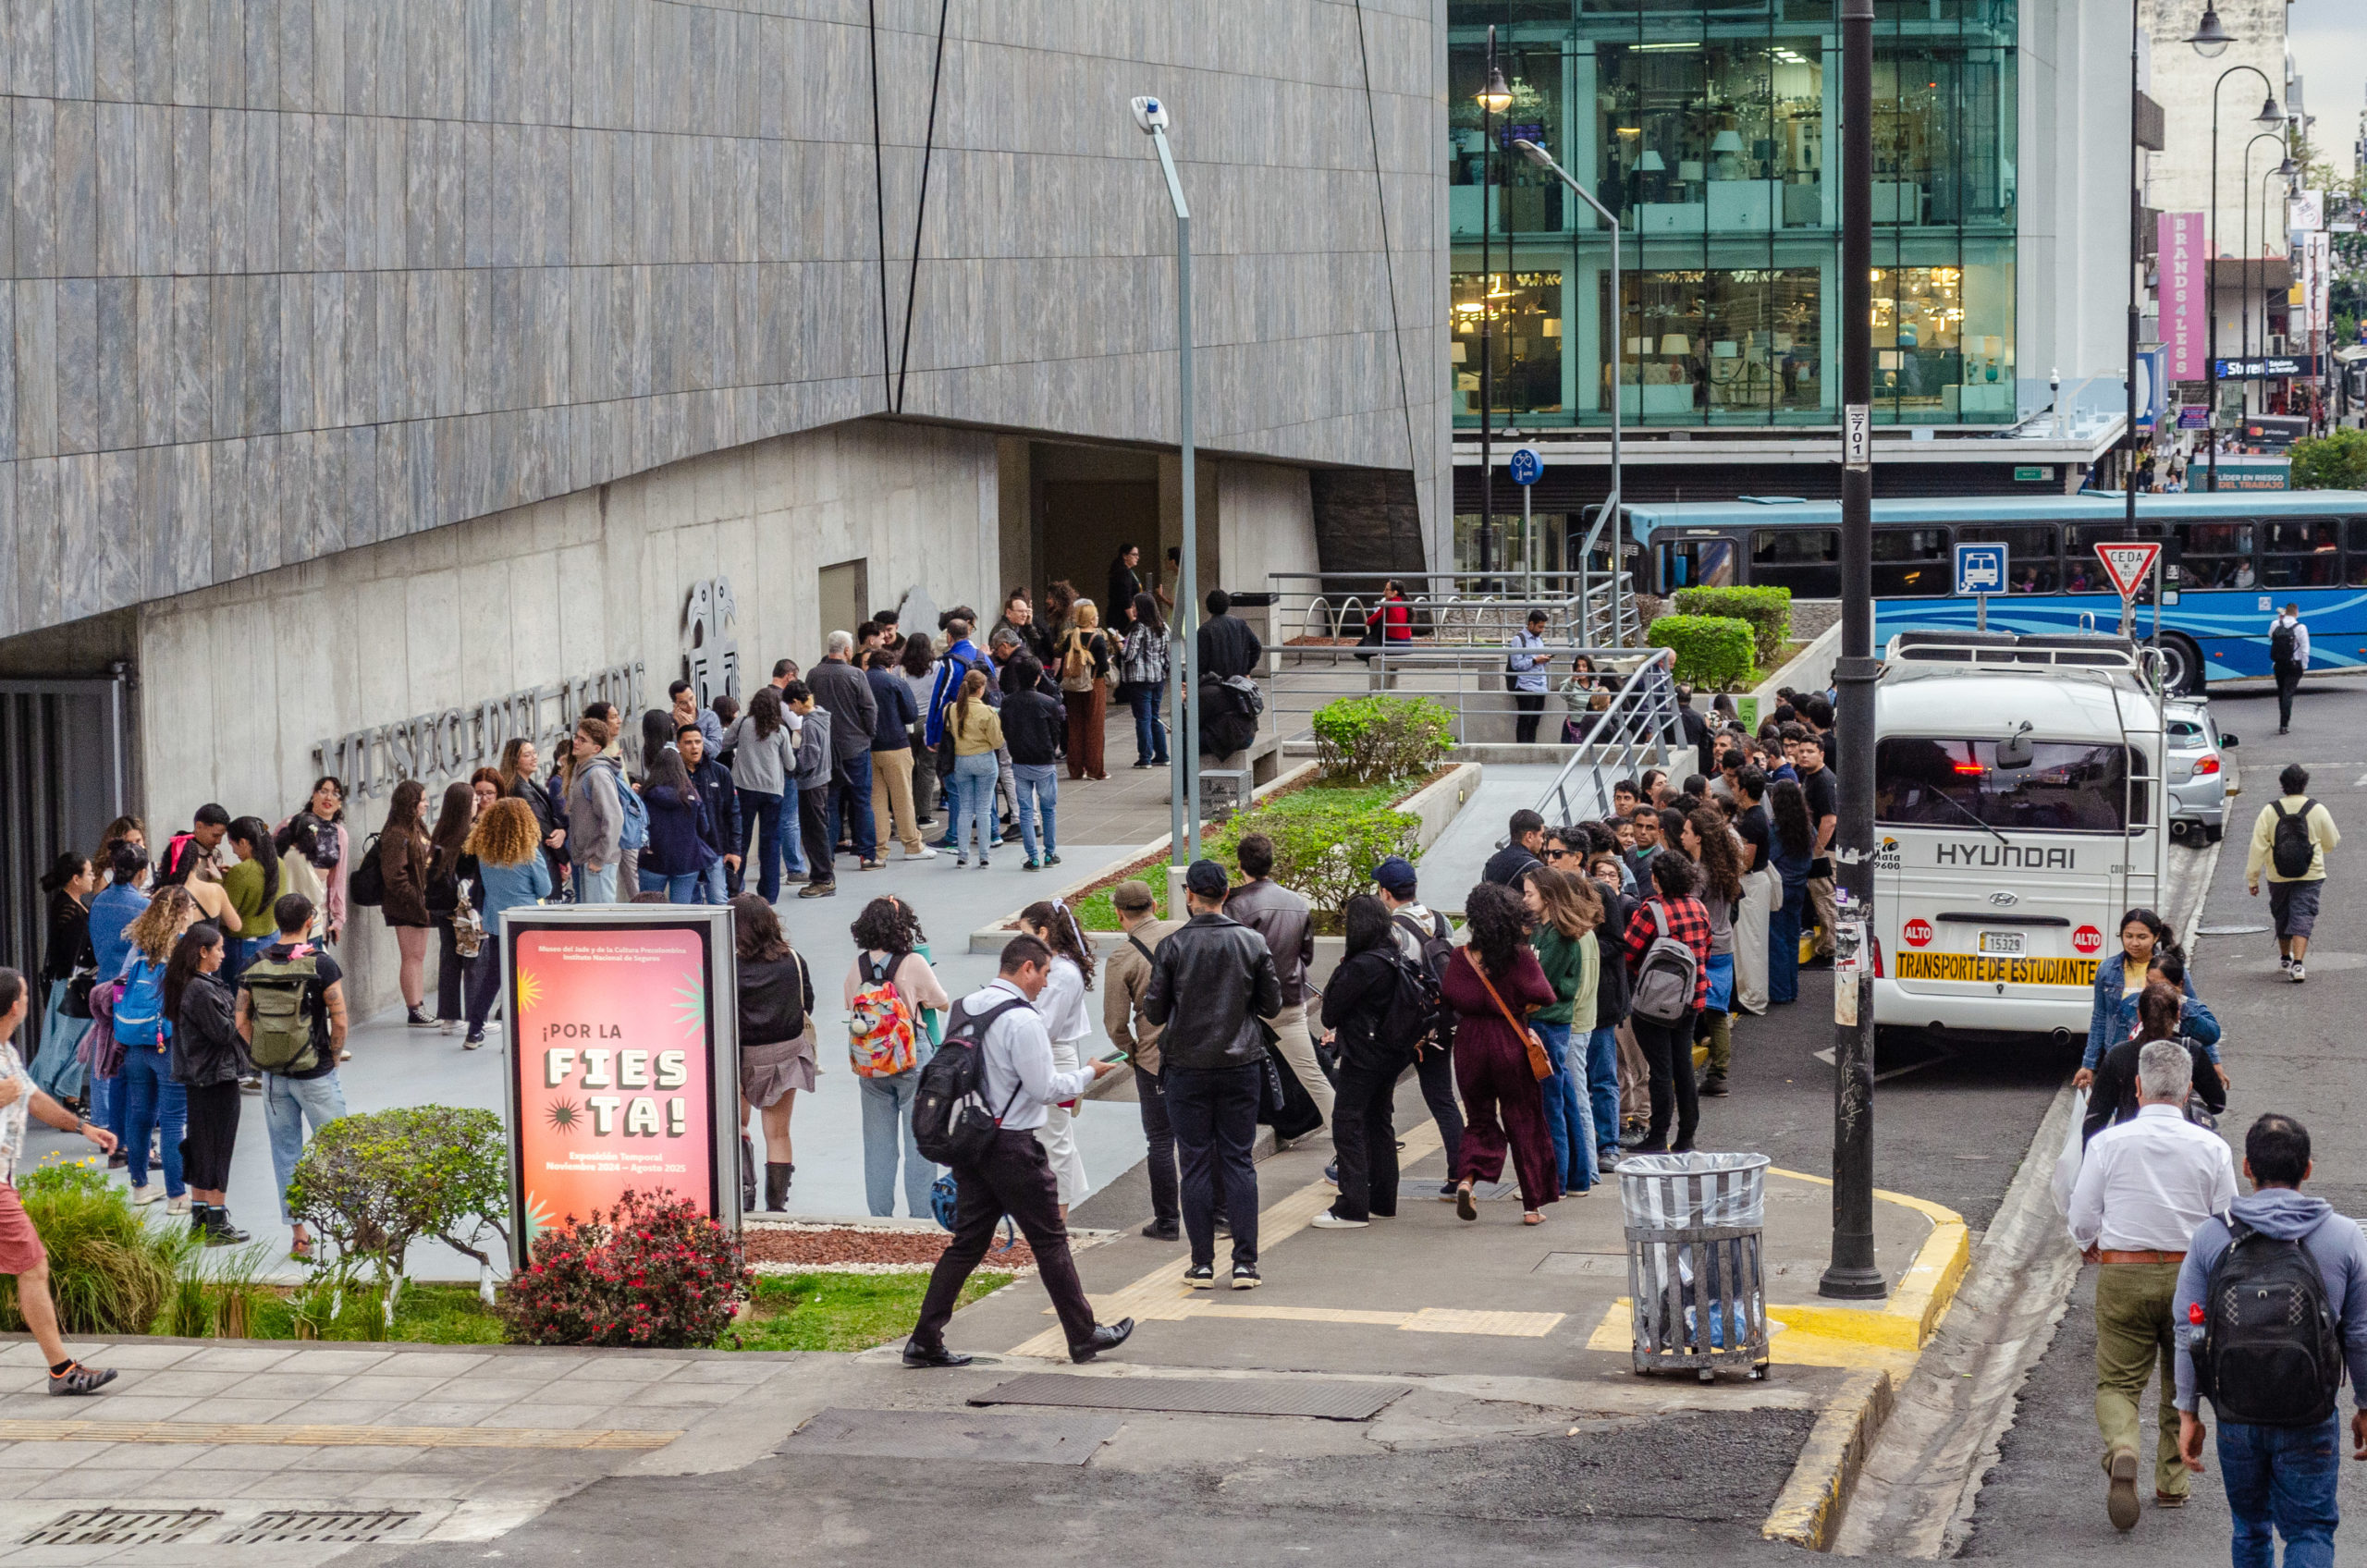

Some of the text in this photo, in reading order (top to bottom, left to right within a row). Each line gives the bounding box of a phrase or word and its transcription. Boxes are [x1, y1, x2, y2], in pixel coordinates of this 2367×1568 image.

[2226, 361, 2264, 375] Stren
[1852, 421, 1862, 454] 701
[2218, 472, 2284, 482] LÍDER EN RIESGO
[2218, 481, 2285, 489] DEL TRABAJO
[2111, 551, 2143, 562] CEDA
[321, 707, 469, 805] MUSEO
[480, 684, 554, 768] DEL
[1936, 842, 2076, 869] HYUNDAI
[1873, 862, 1900, 870] 9600
[2111, 864, 2137, 874] COUTY
[1905, 926, 1932, 940] ALTO
[1990, 937, 2020, 950] 15329
[2073, 934, 2101, 947] ALTO
[633, 955, 660, 963] Seguros
[1898, 953, 2101, 986] TRANSPORTE DE ESTUDIANTE
[543, 1023, 622, 1042] ¡POR LA
[545, 1047, 688, 1091] FIES
[585, 1096, 686, 1138] TA!
[569, 1152, 663, 1162] Exposición Temporal
[546, 1161, 596, 1171] Noviembre
[597, 1162, 620, 1172] 2024
[630, 1163, 663, 1174] Agosto
[664, 1164, 686, 1173] 2025
